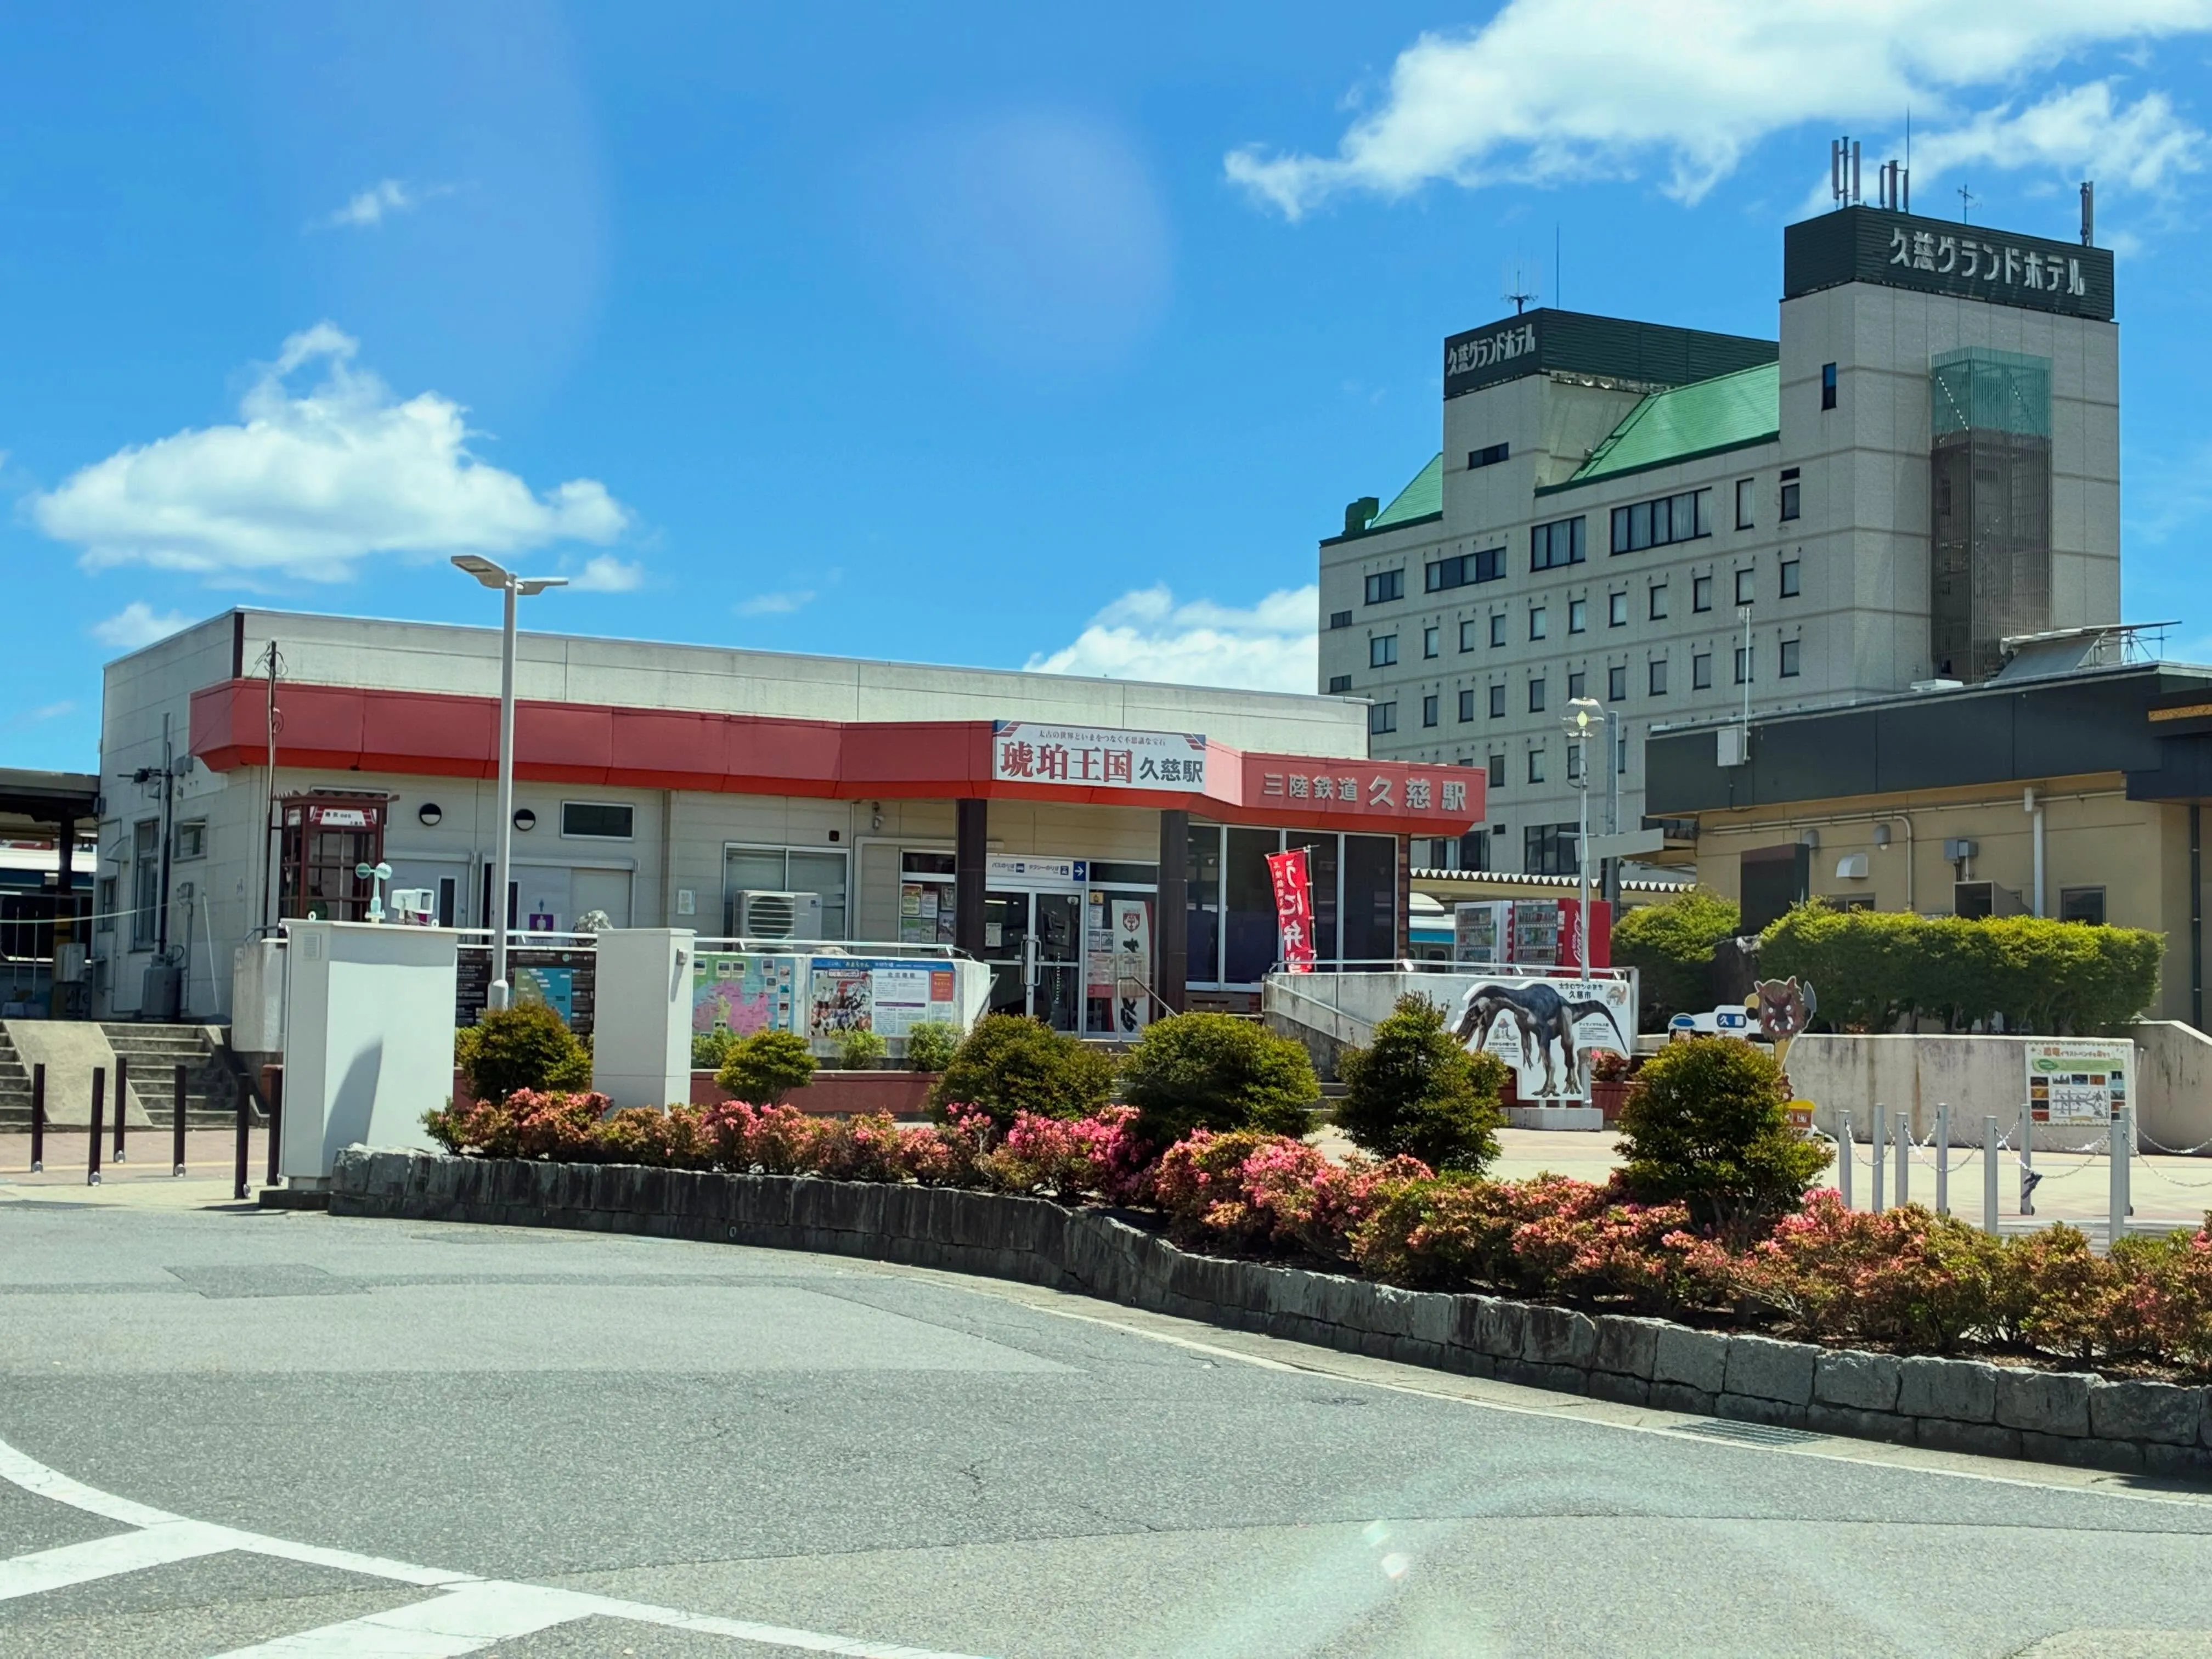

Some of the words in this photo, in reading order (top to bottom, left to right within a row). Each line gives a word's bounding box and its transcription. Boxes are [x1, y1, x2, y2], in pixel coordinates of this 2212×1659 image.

[1889, 227, 2085, 296] 久慈グランドホテル
[1447, 323, 1536, 377] 久慈グランドホテル
[1000, 741, 1133, 784] 琥珀王国
[1138, 756, 1203, 783] 久慈駅
